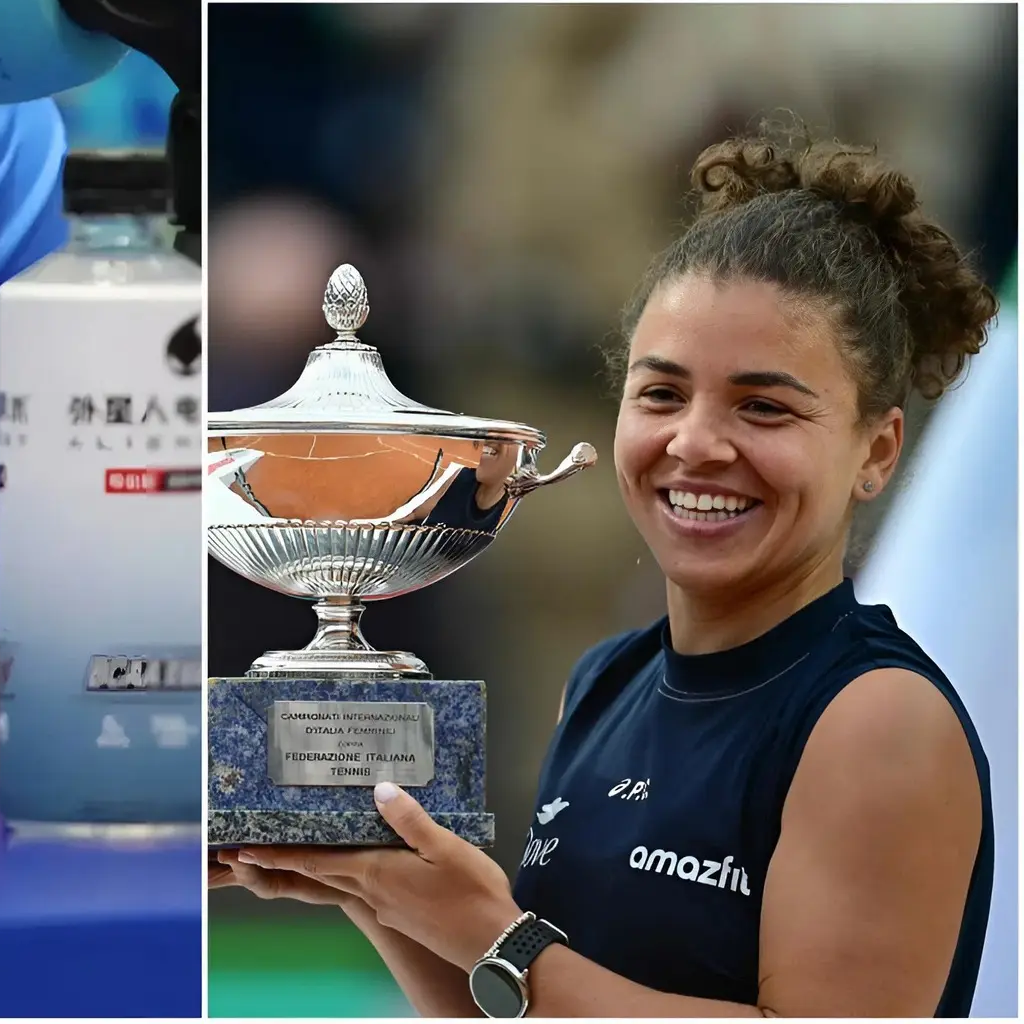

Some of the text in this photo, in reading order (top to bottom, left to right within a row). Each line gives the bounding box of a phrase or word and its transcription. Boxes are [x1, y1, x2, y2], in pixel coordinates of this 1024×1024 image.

[285, 752, 416, 763] FEDERAZIONE ITALIANA
[331, 767, 371, 777] TENNIS
